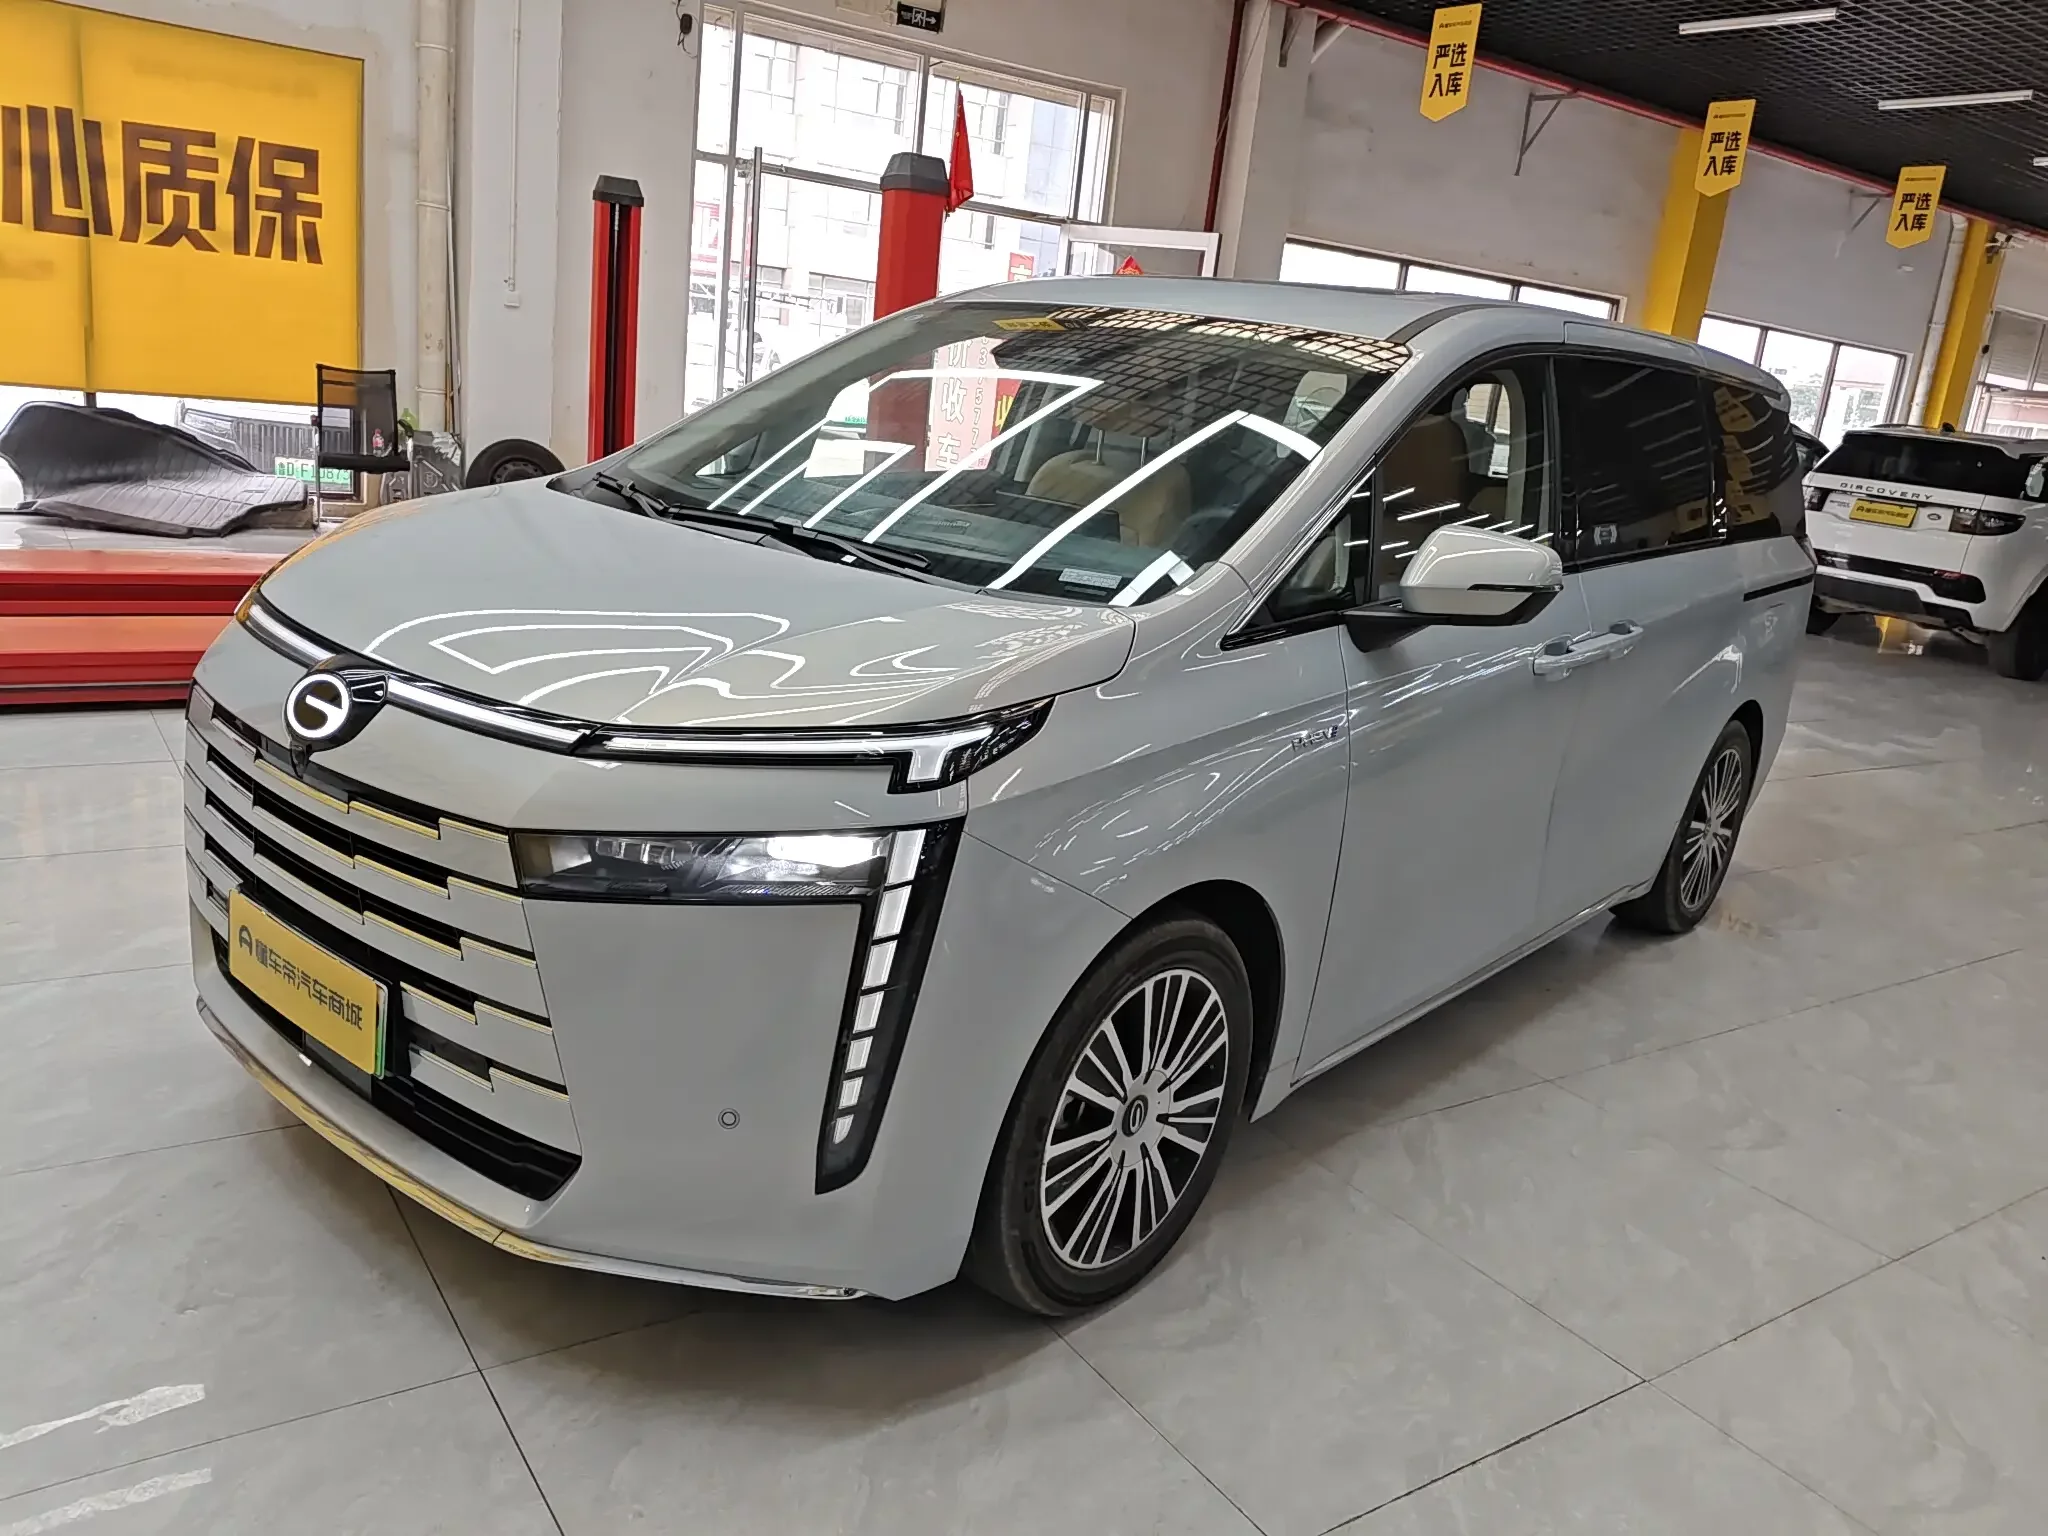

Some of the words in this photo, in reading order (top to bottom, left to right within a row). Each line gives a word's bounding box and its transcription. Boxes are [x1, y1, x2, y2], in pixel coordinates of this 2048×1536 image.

[1433, 42, 1468, 69] 严选
[1428, 71, 1464, 98] 入库
[1707, 130, 1742, 153] 严选
[1703, 155, 1738, 176] 入库
[0, 104, 324, 265] 心质保
[1899, 191, 1932, 210] 严选
[1894, 213, 1928, 231] 入库
[1839, 481, 1935, 501] DISCOVERY
[254, 937, 364, 1031] 懂车帝汽车商城
